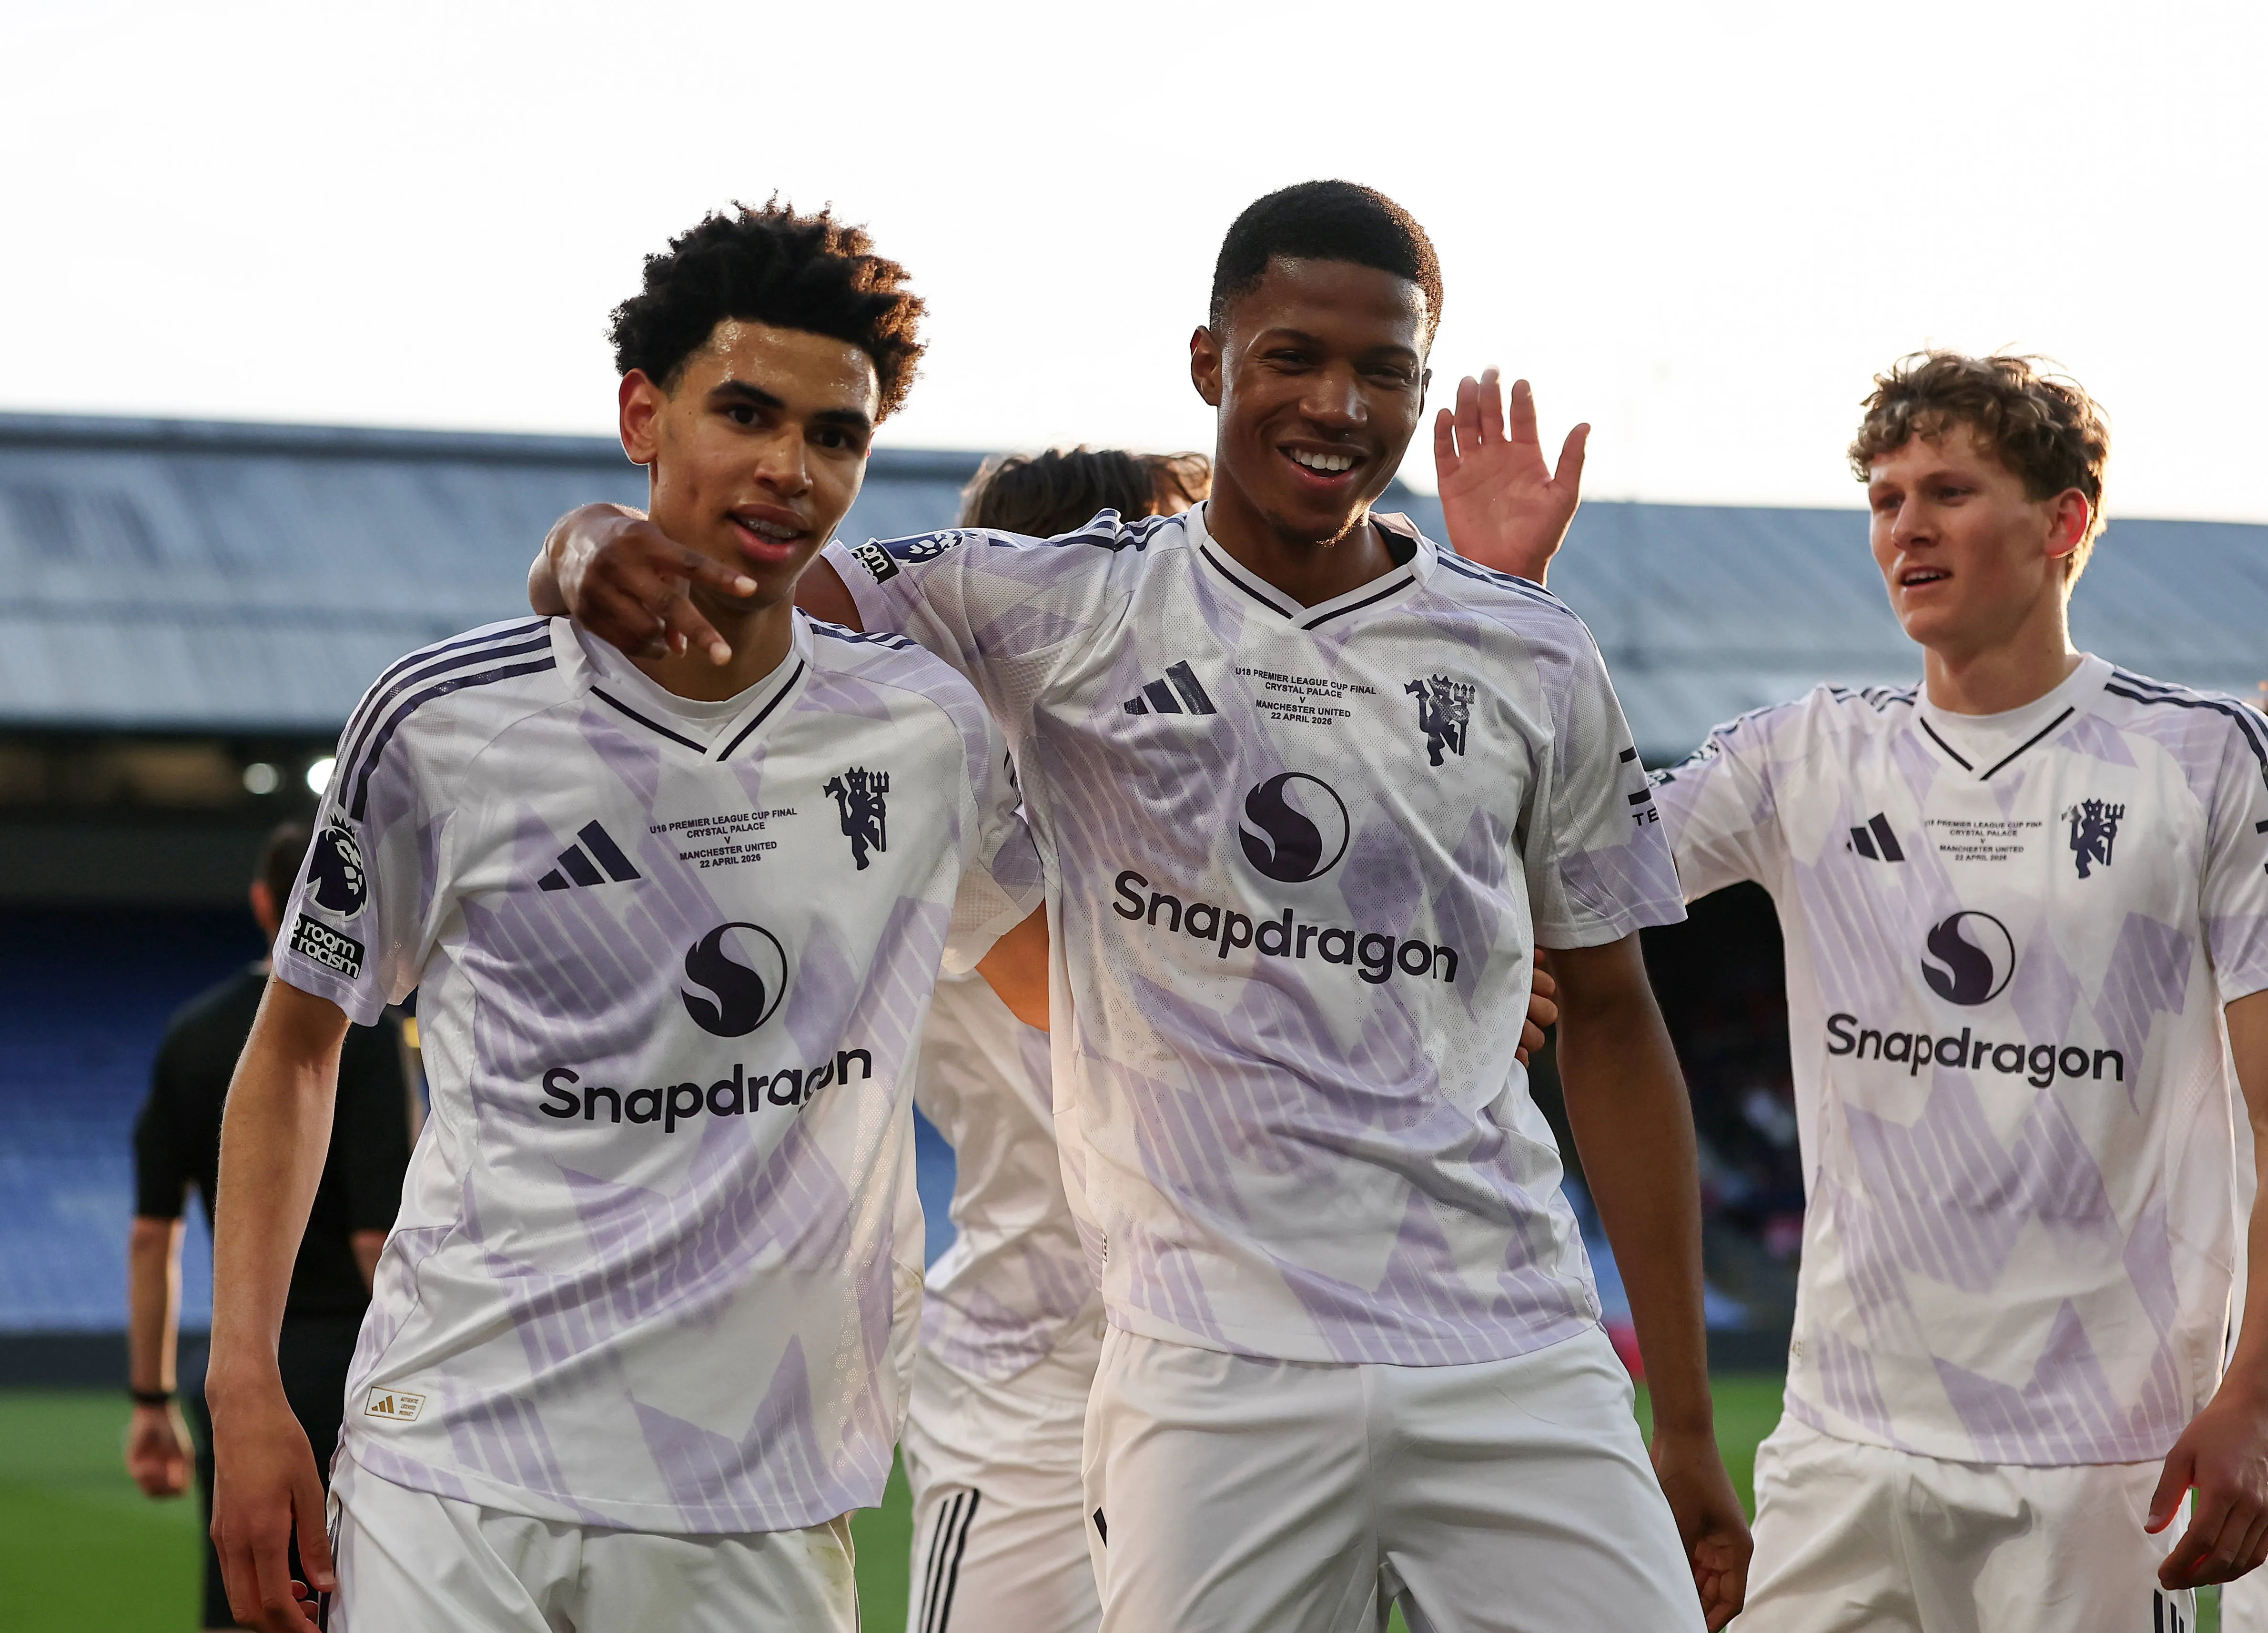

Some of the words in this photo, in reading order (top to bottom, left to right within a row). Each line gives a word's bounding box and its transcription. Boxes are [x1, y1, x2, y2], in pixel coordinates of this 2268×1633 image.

[1235, 667, 1251, 676] U18
[1254, 669, 1288, 683] PREMIER
[1291, 677, 1328, 687] LEAGUE
[1330, 681, 1348, 690] CUP
[1350, 685, 1377, 694] FINAL
[1265, 681, 1304, 694] CRYSTAL
[1307, 687, 1342, 698] PALACE
[1256, 700, 1315, 714] MANCHESTER
[1318, 707, 1351, 717] UNITED
[1282, 713, 1309, 723] APRIL
[1312, 717, 1332, 725] 2026
[669, 818, 710, 831] PREMIER
[712, 813, 749, 825] LEAGUE
[751, 811, 770, 821] CUP
[772, 808, 798, 818] FINAL
[687, 826, 728, 839] CRYSTAL
[730, 822, 766, 833] PALACE
[679, 845, 743, 861] MANCHESTER
[745, 841, 777, 852] UNITED
[700, 860, 710, 868] 22
[712, 857, 739, 867] APRIL
[741, 853, 761, 863] 2026
[1113, 870, 1458, 984] Snapdragon
[304, 922, 355, 958] room
[297, 936, 359, 979] racism
[1827, 1013, 2124, 1088] Snapdragon
